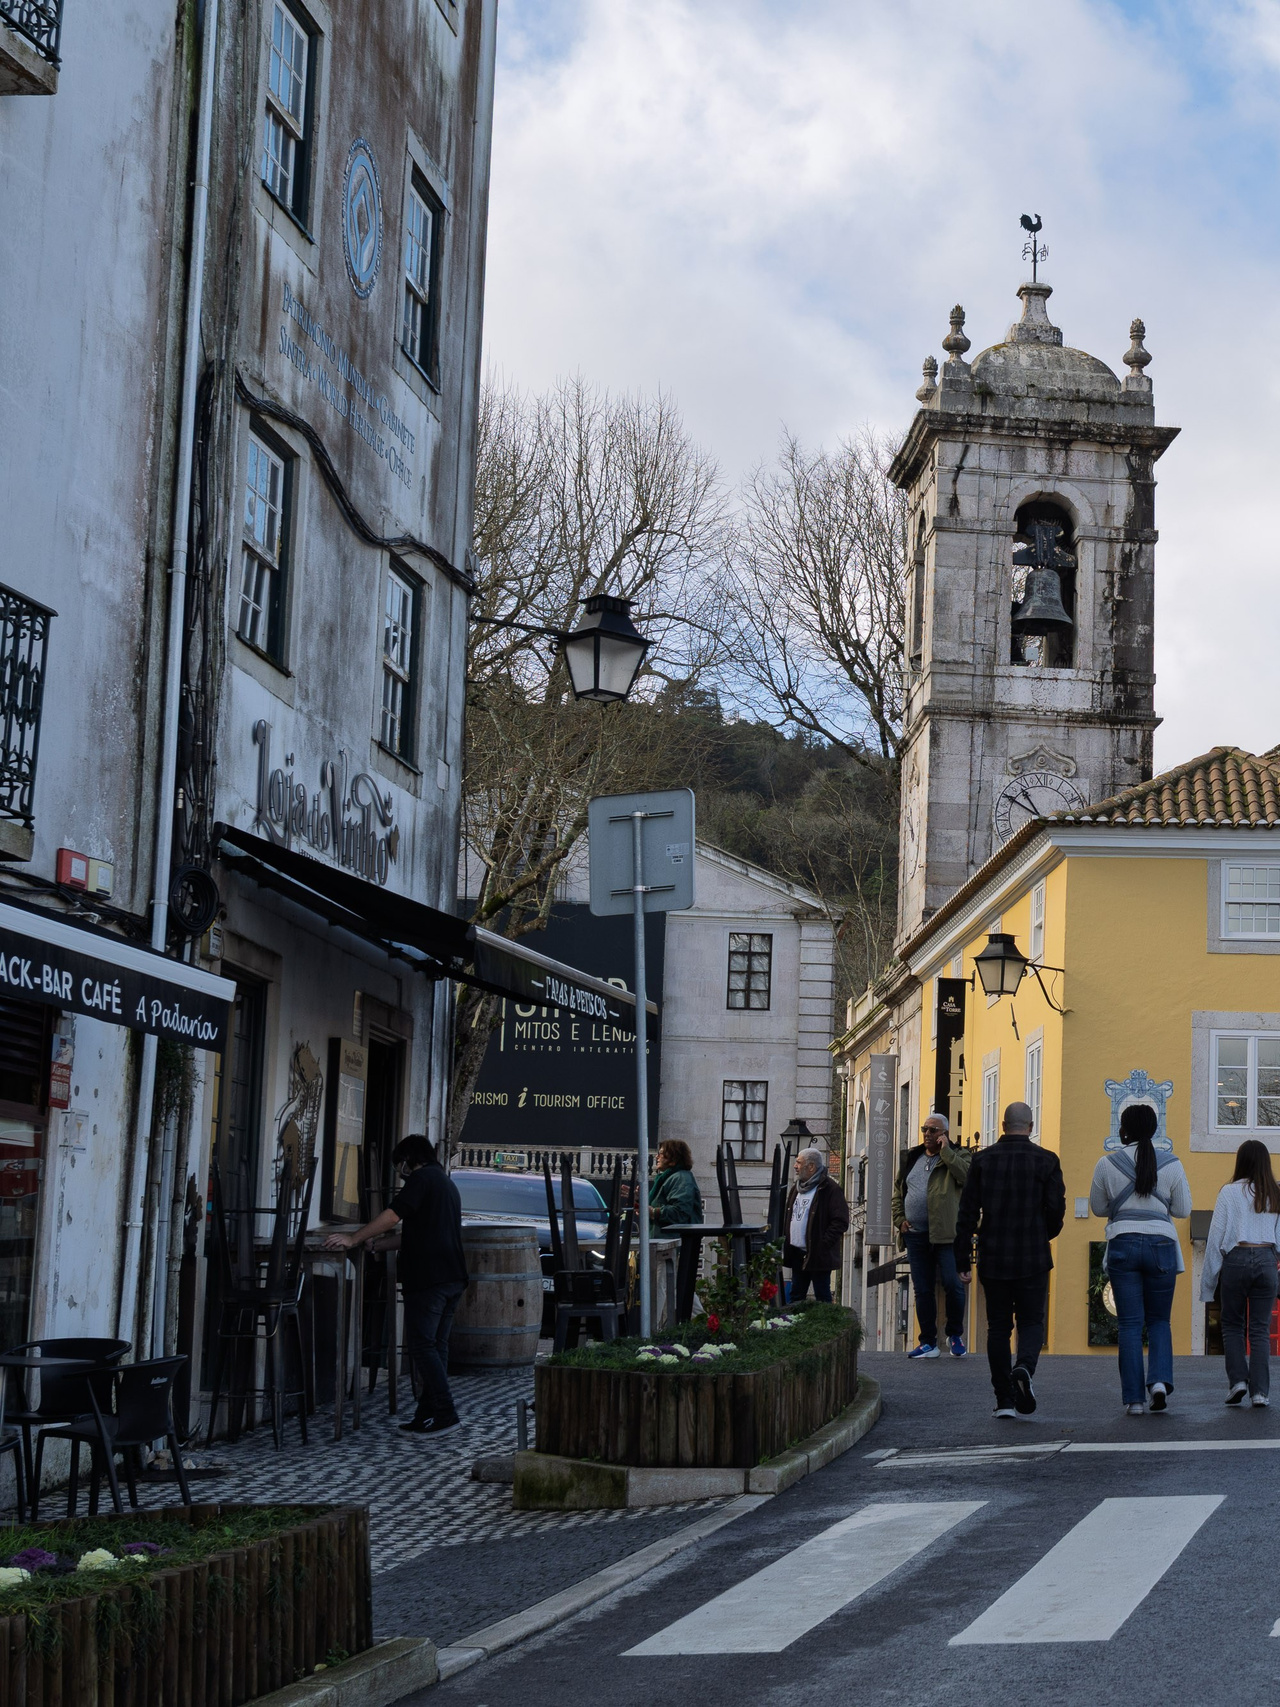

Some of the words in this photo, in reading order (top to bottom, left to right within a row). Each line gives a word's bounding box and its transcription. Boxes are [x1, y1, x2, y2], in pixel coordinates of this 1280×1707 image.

[282, 282, 336, 364] PATRIMÓNIO
[337, 348, 375, 409] MUNDIAL
[380, 395, 415, 454] GABINETE
[279, 325, 312, 382] SINTRA
[318, 364, 347, 417] WORLD
[349, 399, 385, 459] HERITAGE
[388, 446, 413, 490] OFFICE
[255, 719, 308, 850] Loja
[326, 748, 393, 886] Vinho
[0, 952, 73, 1000] ACK-BAR
[81, 979, 122, 1014] CAFÉ
[136, 996, 147, 1022] A
[545, 976, 568, 1006] TAPAS
[570, 986, 576, 1009] &
[576, 989, 607, 1019] PETISCOS
[514, 1021, 560, 1040] MITOS
[571, 1023, 580, 1041] E
[592, 1023, 650, 1043] LEND
[514, 1044, 561, 1052] CENTRO
[573, 1046, 650, 1055] INTERATIO
[470, 1091, 508, 1106] RISMO
[533, 1093, 580, 1108] TOURISM
[586, 1095, 625, 1109] OFFICE
[503, 1154, 518, 1162] TAXI
